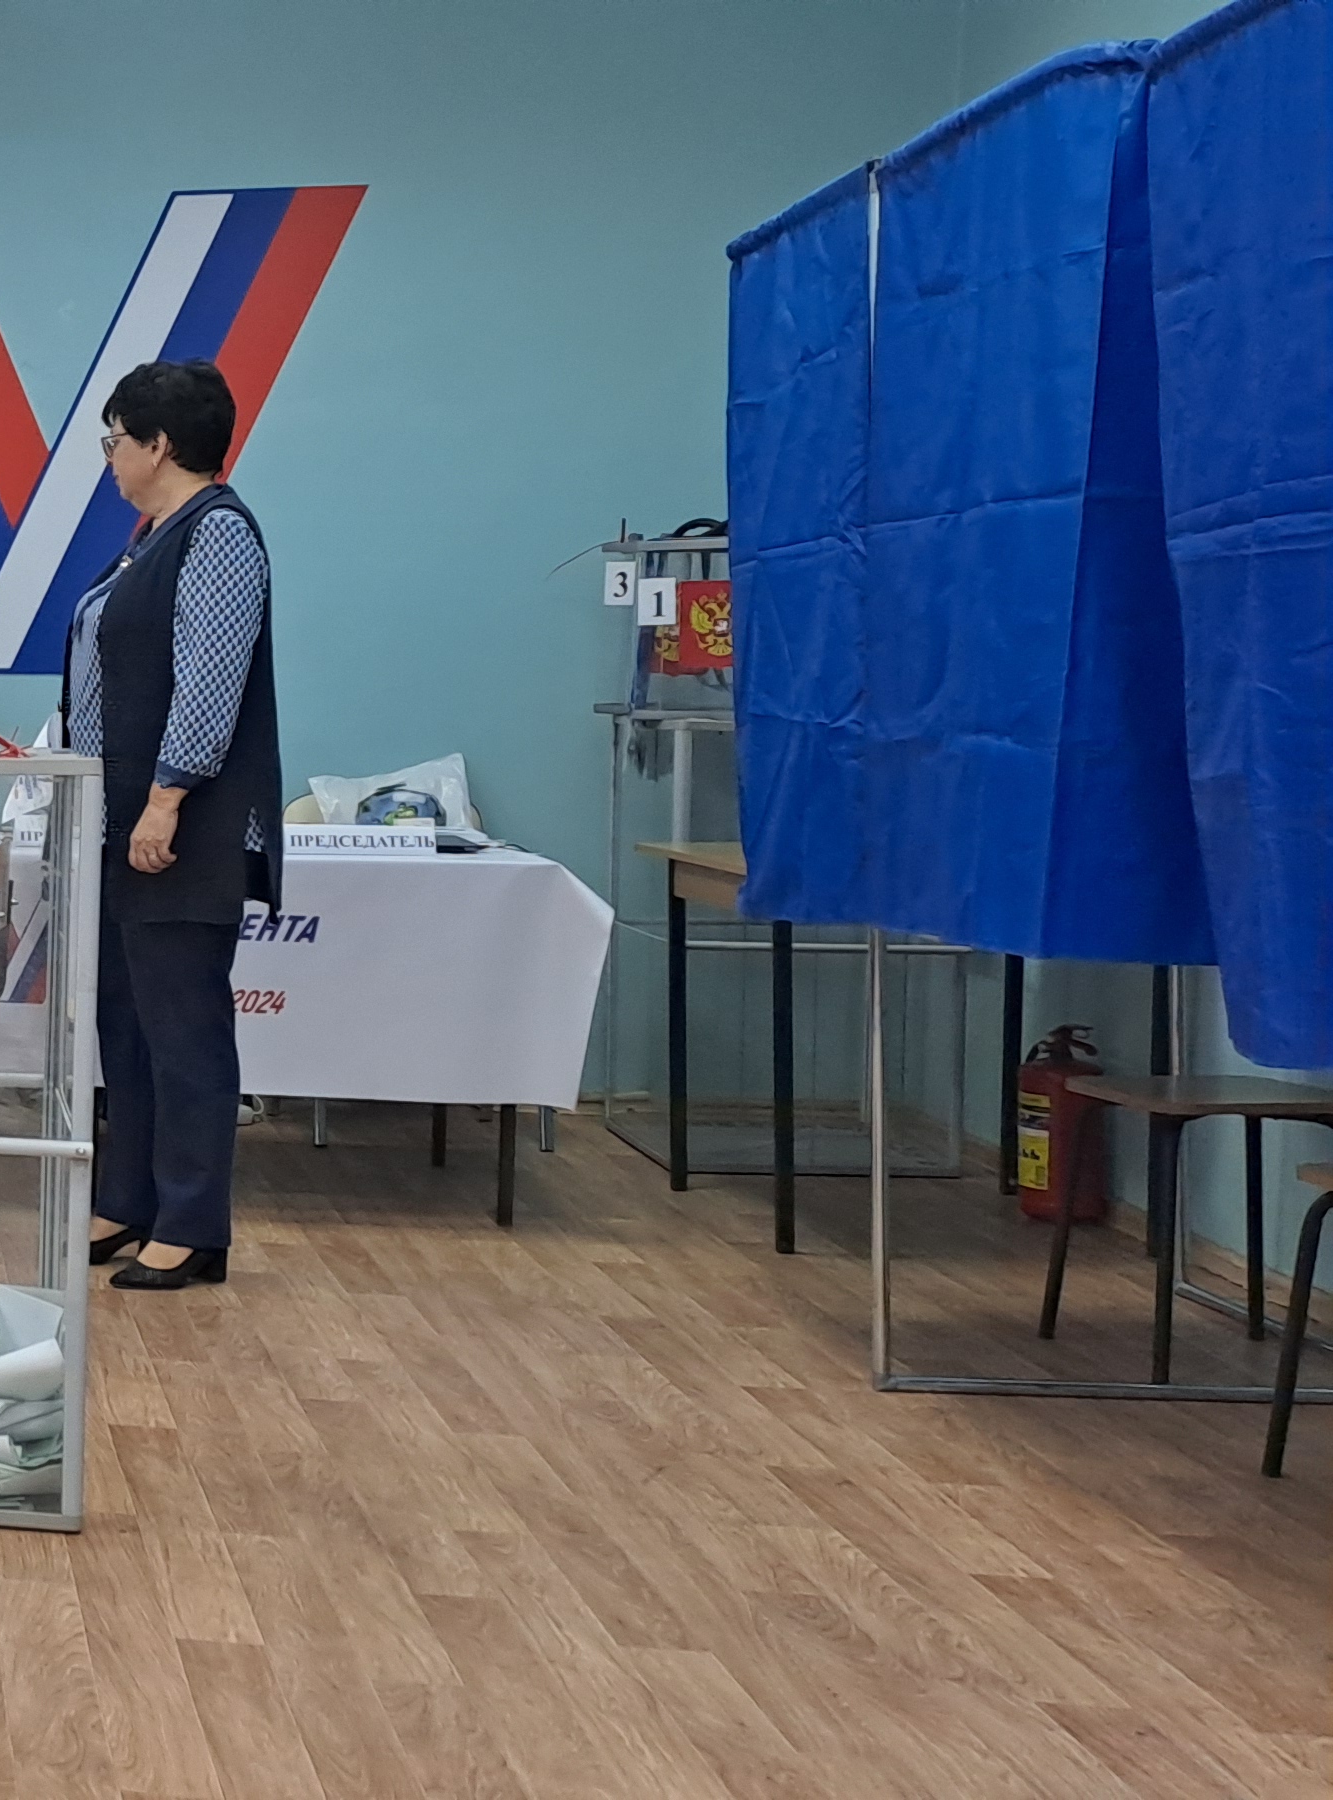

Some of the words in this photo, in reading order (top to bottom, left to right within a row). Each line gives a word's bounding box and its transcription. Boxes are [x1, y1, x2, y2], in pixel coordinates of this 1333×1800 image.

[613, 572, 628, 598] 3
[652, 591, 666, 618] 1
[289, 834, 436, 850] ПРЕДСЕДАТЕЛЬ
[238, 914, 321, 944] ЕНТА
[233, 989, 286, 1014] 2024
